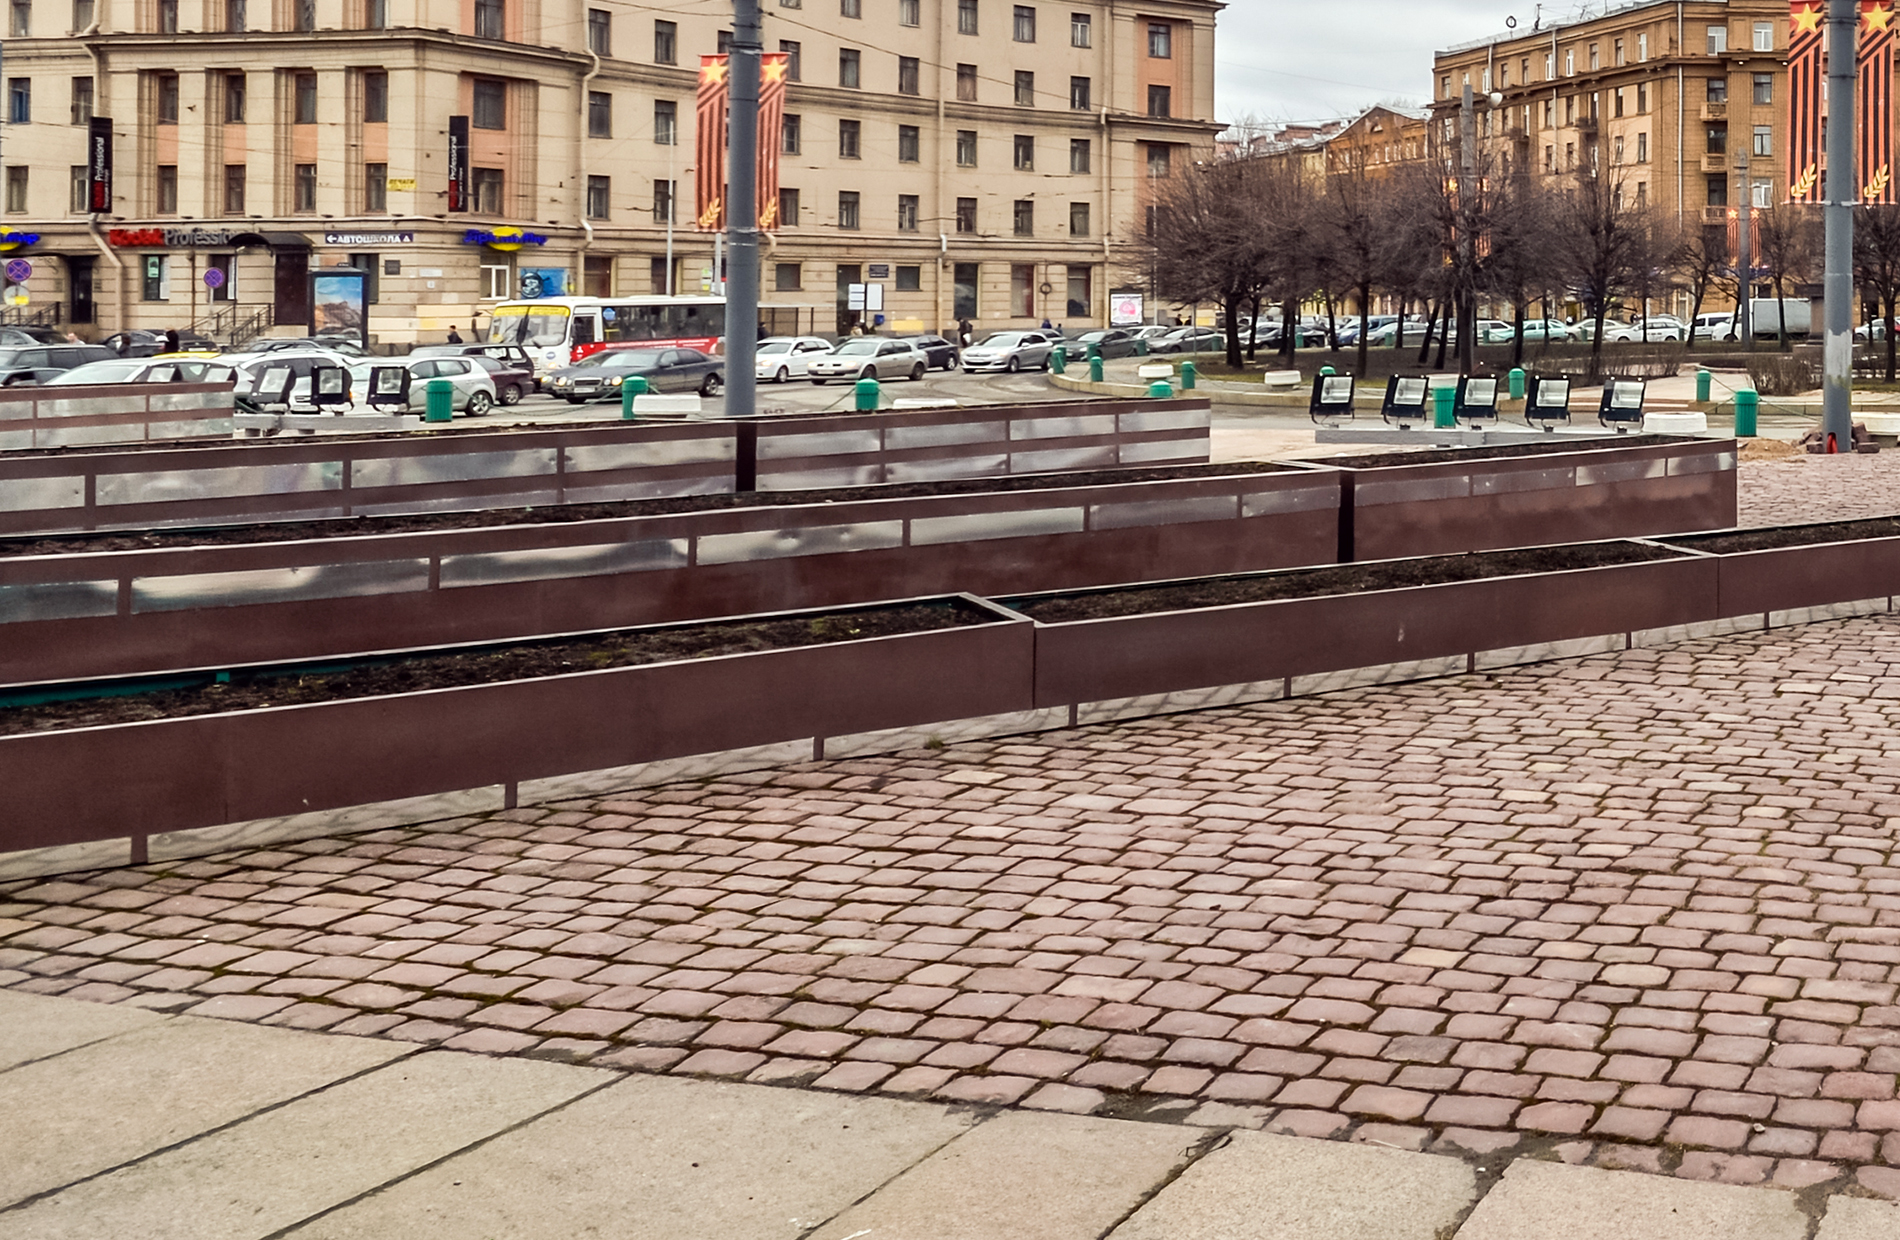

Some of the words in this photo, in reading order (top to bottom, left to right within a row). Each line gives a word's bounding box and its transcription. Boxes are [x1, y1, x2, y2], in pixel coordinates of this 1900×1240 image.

[94, 136, 105, 181] Professional
[449, 136, 457, 180] Professional
[109, 228, 164, 246] Kodak
[164, 228, 240, 246] Professio
[337, 234, 401, 244] АВТОШКОЛА
